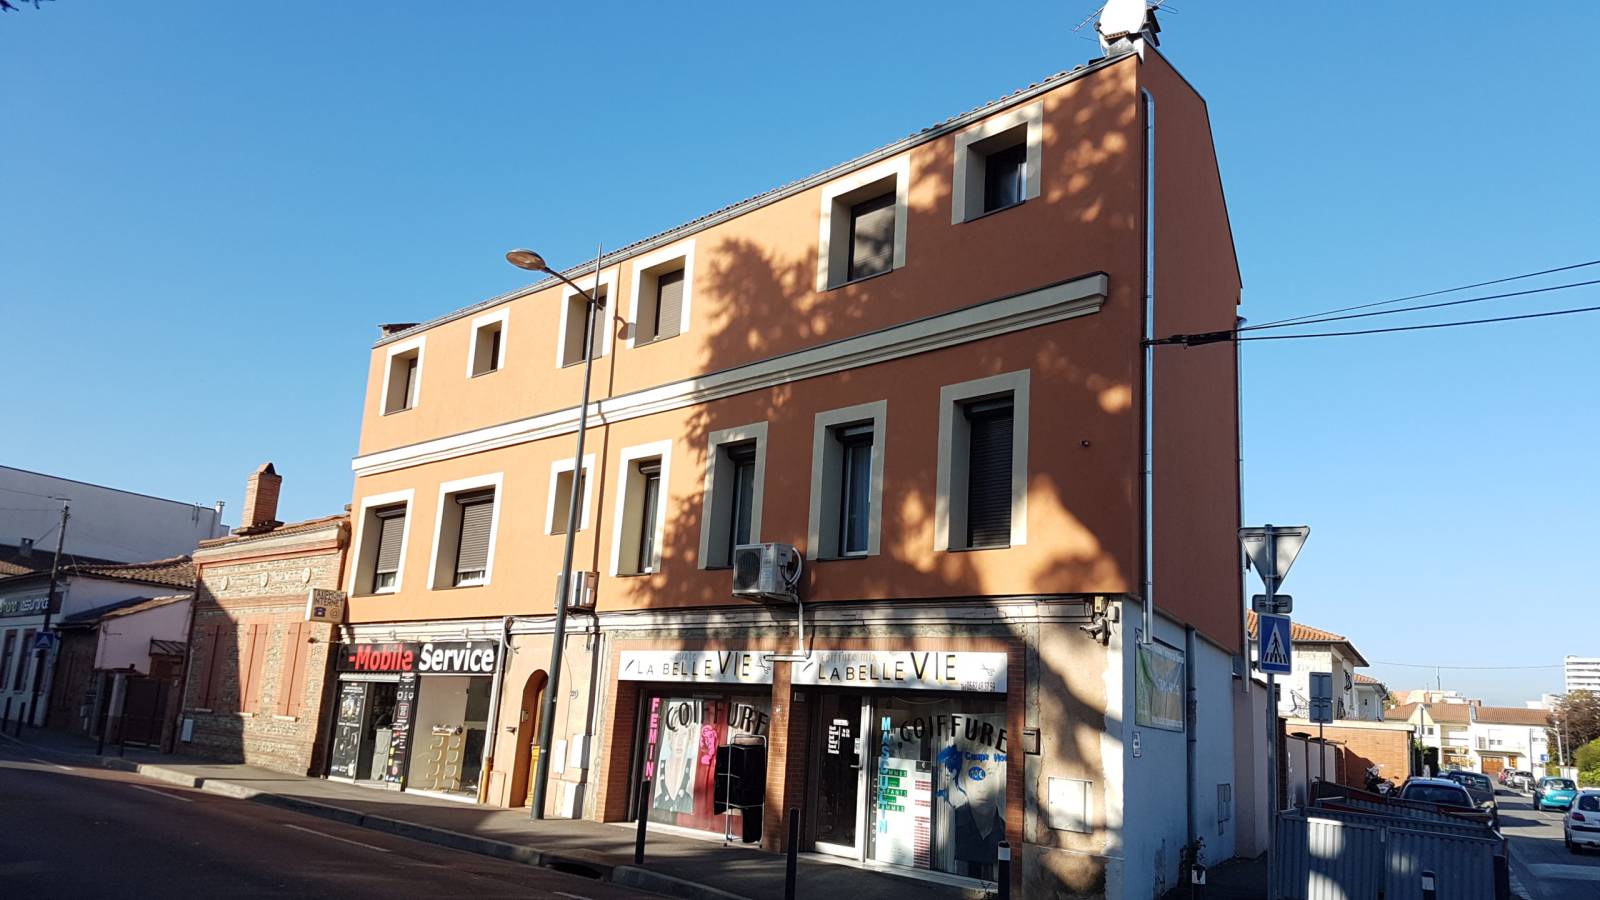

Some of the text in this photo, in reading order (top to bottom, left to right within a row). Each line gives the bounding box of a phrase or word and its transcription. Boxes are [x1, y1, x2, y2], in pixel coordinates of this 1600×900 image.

[418, 642, 494, 672] Service
[638, 650, 751, 677] LA BELLE VIE
[818, 651, 956, 681] LA BELLE VIE
[900, 714, 1008, 754] COIFFURE
